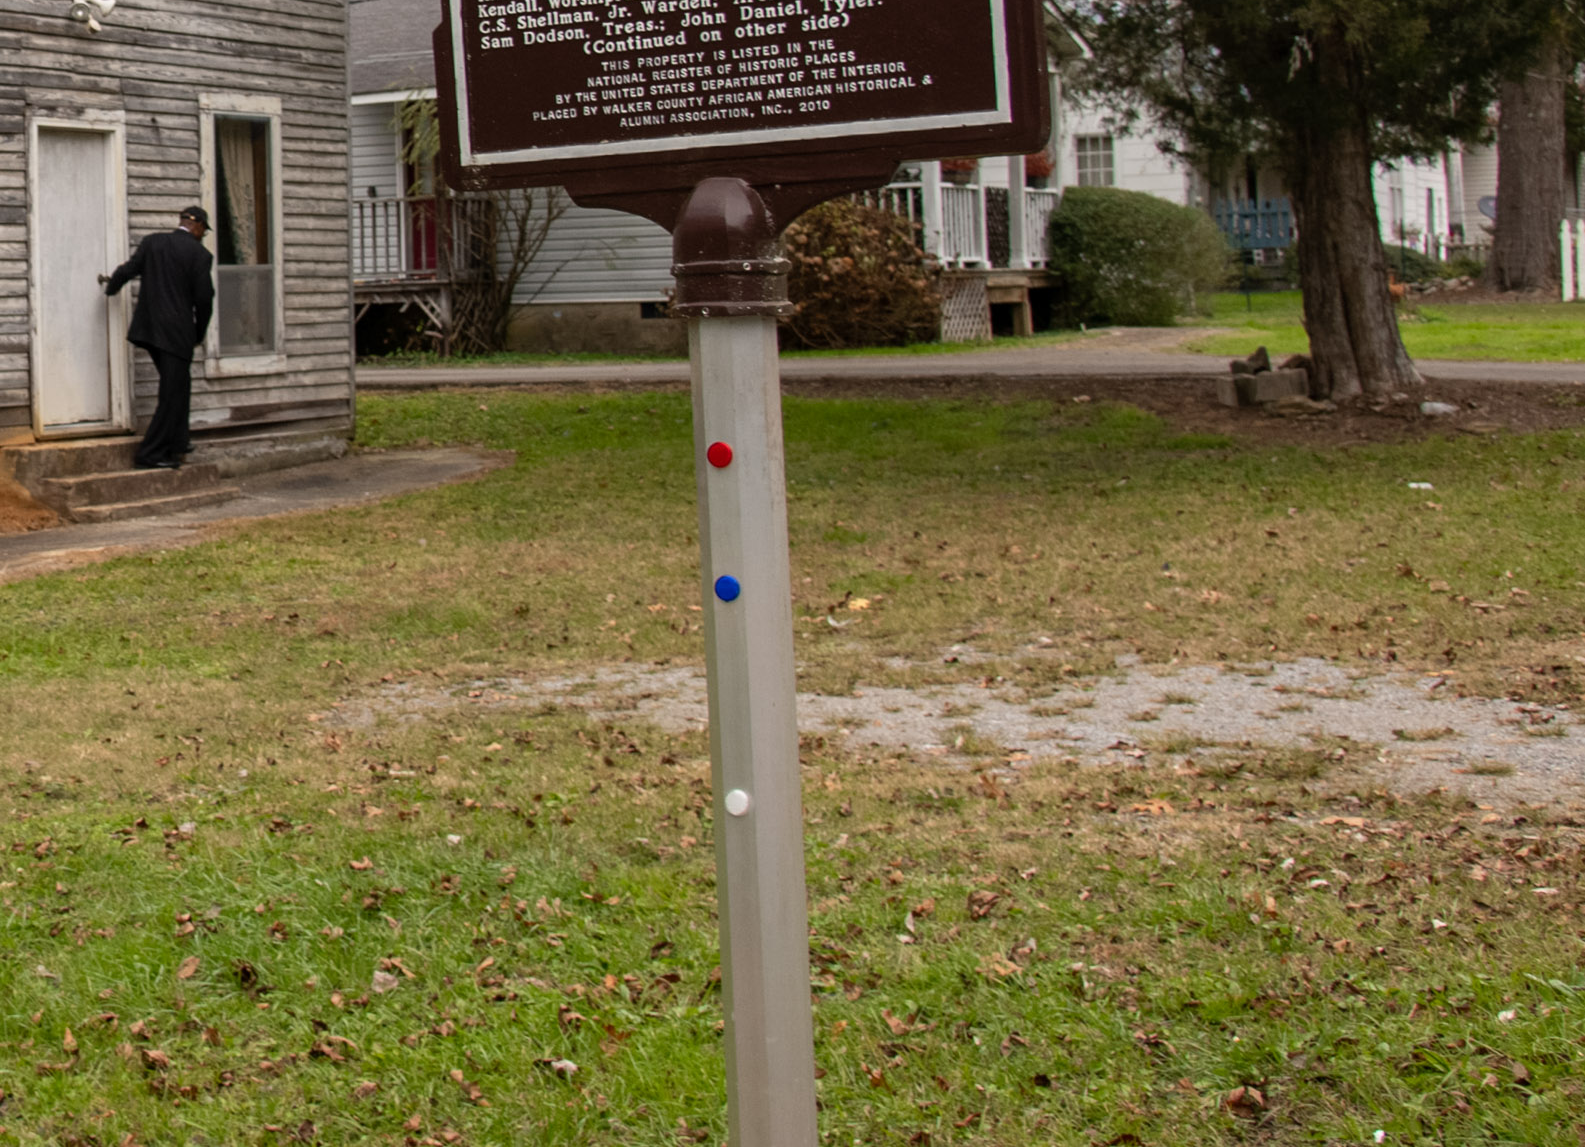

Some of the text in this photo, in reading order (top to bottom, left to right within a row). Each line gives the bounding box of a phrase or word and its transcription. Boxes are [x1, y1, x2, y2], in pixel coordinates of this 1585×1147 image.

[478, 17, 511, 34] C.S.
[516, 10, 600, 30] Shellman,
[607, 4, 632, 19] Jr.
[480, 35, 515, 50] Sam
[522, 28, 591, 45] Dodson,
[601, 19, 665, 36] Treas.;
[680, 11, 727, 28] John
[739, 0, 809, 21] Daniel,
[583, 12, 850, 55] (Continued on other side)
[587, 50, 856, 88] NATIONAL REGISTER OF HISTORIC PLACES
[601, 38, 835, 72] THIS PROPERTY IS LISTED IN THE
[532, 74, 933, 121] PLACED BY WALKER COUNTY AFRICAN AMERICAN HISTORICAL &
[555, 61, 907, 105] BY THE UNITED STATES DEPARTMENT OF THE INTERIOR
[619, 99, 831, 128] ALUMNI ASSOCIATION, INC., 2010
